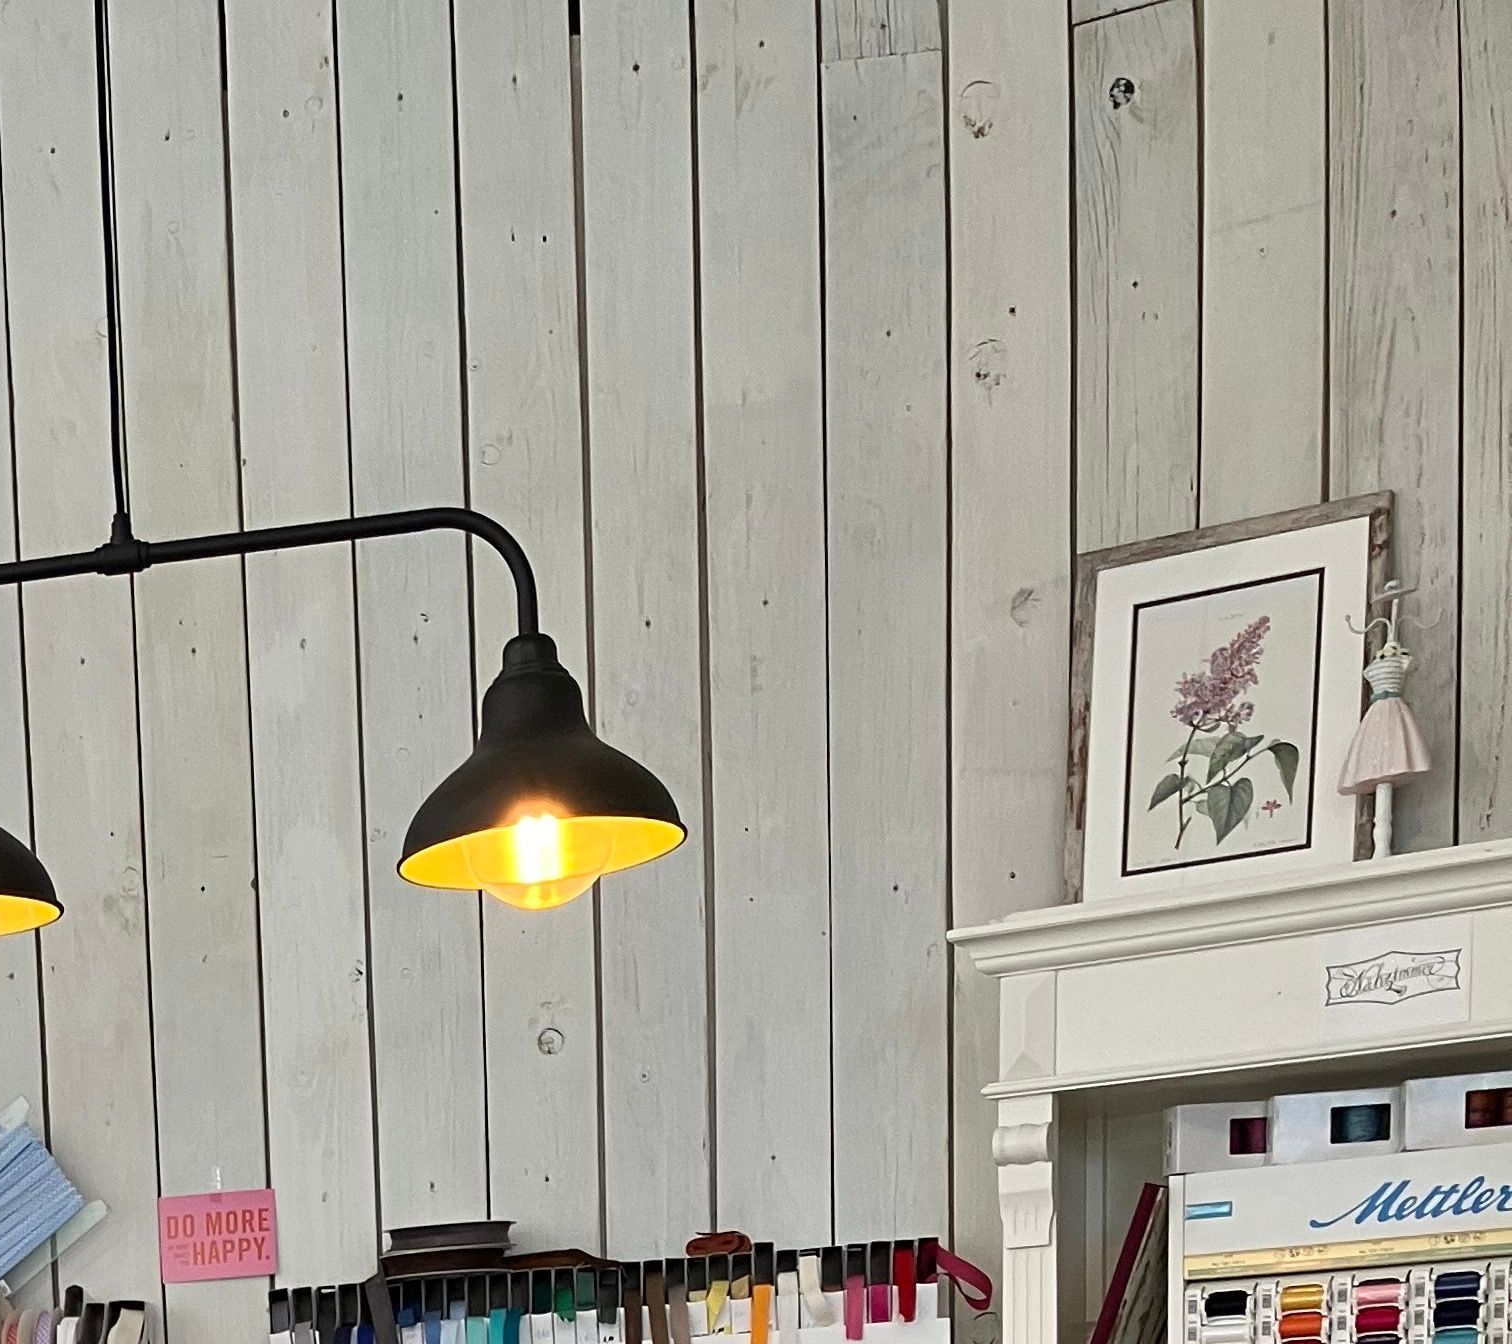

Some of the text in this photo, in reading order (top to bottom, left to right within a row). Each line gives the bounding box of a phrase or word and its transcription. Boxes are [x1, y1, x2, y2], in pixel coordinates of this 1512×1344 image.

[167, 1207, 270, 1239] DO MORE
[192, 1236, 270, 1266] HAPPY.
